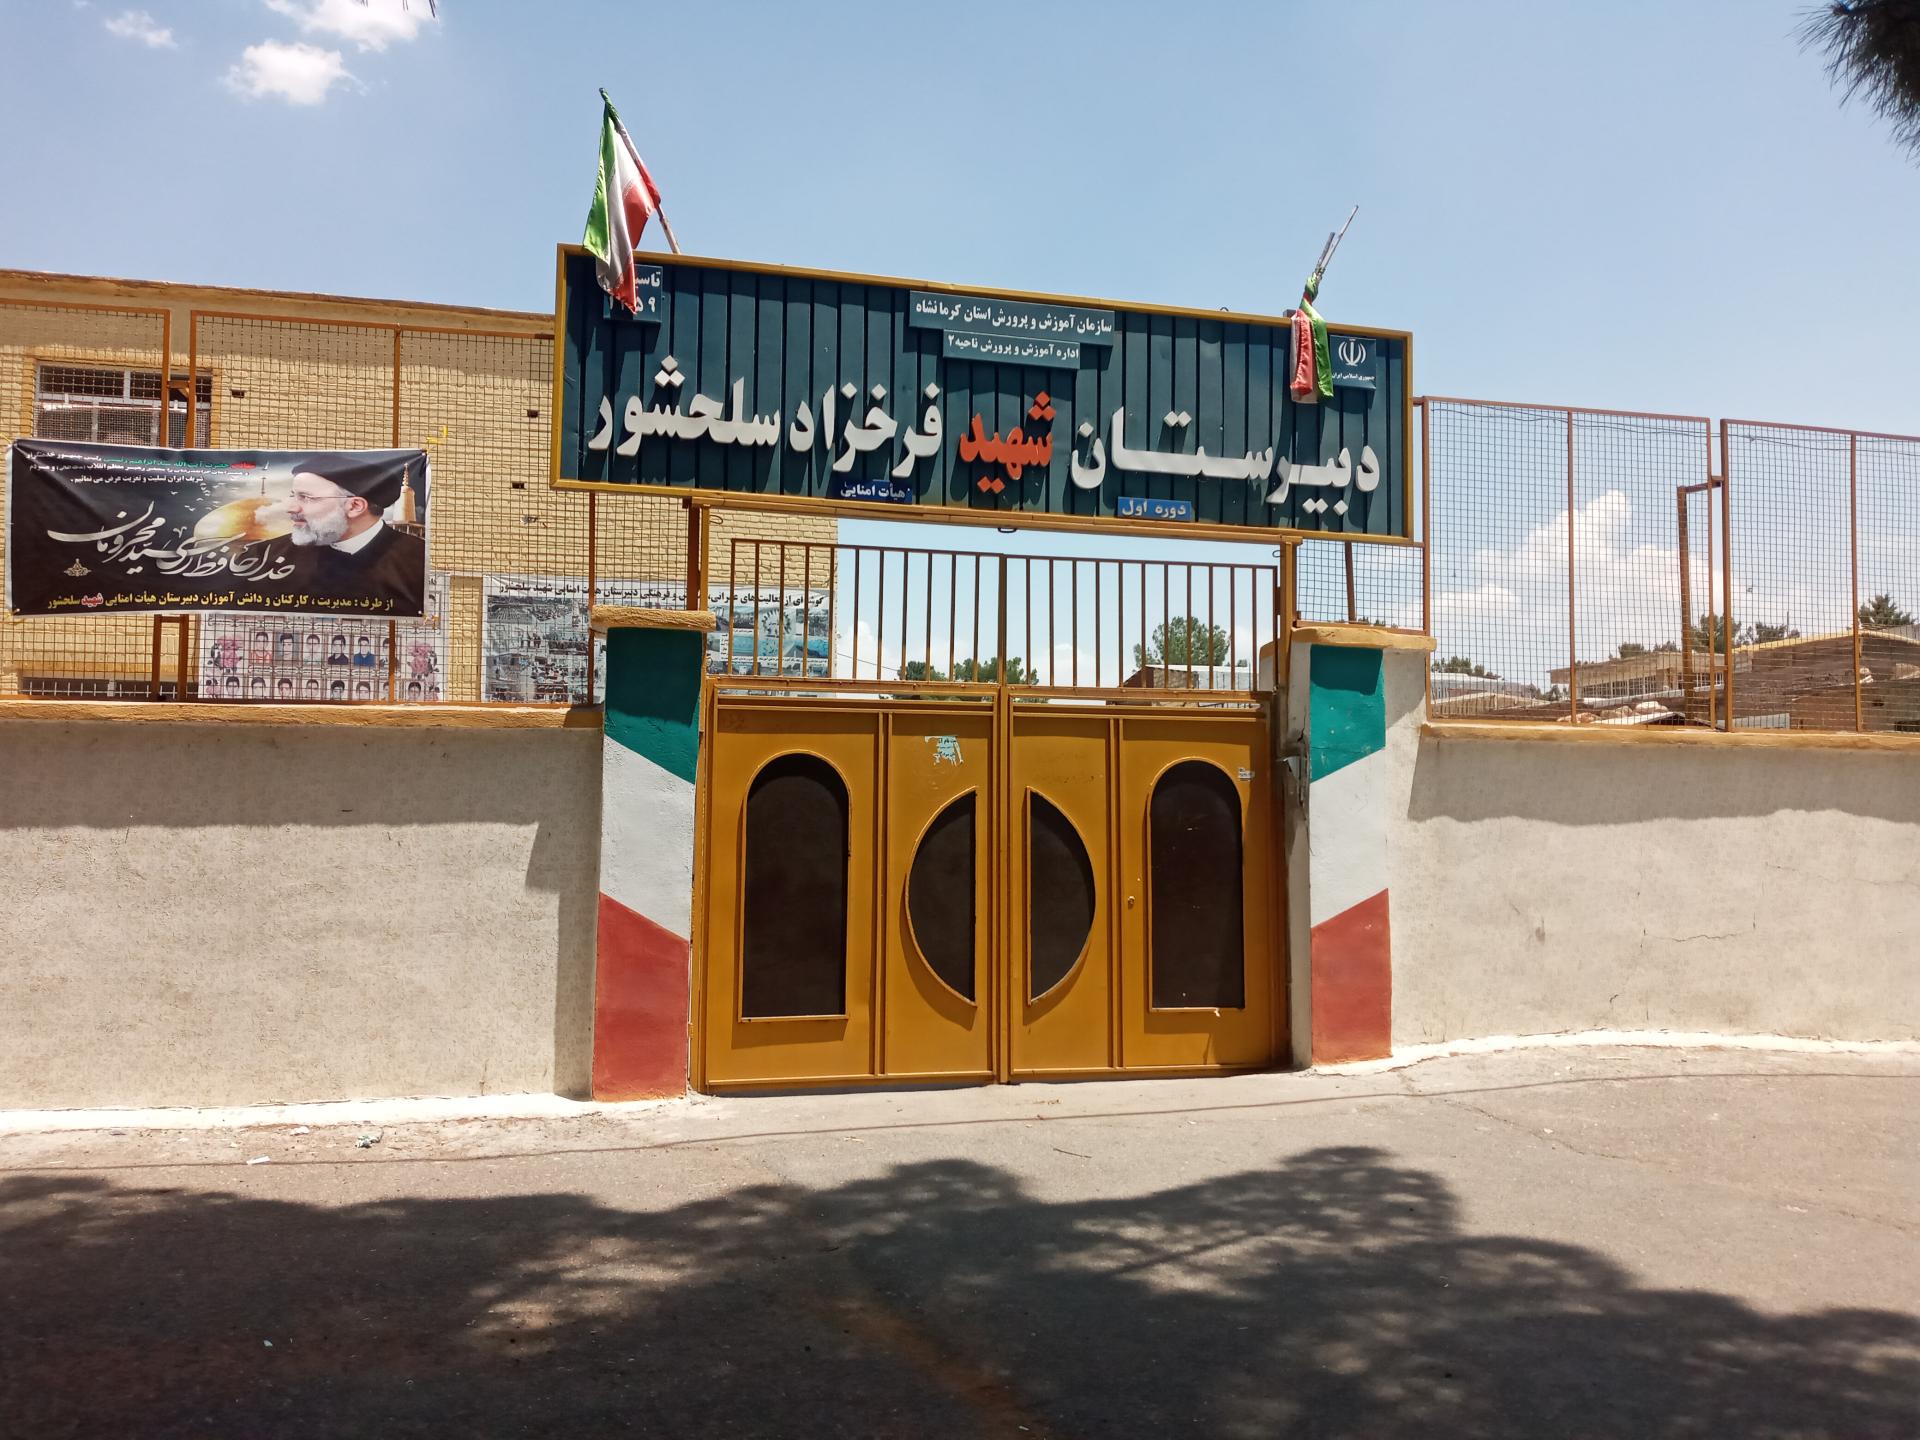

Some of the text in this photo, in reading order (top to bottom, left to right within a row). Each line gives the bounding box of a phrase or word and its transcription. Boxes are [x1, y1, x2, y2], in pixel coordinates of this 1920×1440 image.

[916, 299, 1112, 336] سازمان آموزش و پرورش استان کرمانشاه
[980, 339, 1012, 356] پرورش
[1013, 345, 1020, 356] و
[1021, 343, 1055, 358] آموزش
[1056, 347, 1079, 361] اداره
[1342, 373, 1358, 381] اسلامی
[588, 355, 1380, 515] دبیرستان شهید فرخزاد سلحشور
[93, 476, 104, 484] می
[104, 475, 122, 484] عرض
[122, 474, 142, 484] تعزیت
[148, 474, 167, 482] تسلیت
[167, 475, 185, 484] ایران
[185, 475, 204, 484] شریف
[840, 482, 876, 498] امنایی
[1121, 499, 1187, 519] دوره اول
[499, 581, 532, 593] سلحشور
[533, 583, 553, 594] شهید
[603, 586, 638, 599] دبیرستان
[47, 594, 80, 609] سلحشور
[81, 592, 104, 608] شهید
[105, 592, 133, 607] امنایی
[134, 590, 157, 605] هیأت
[158, 591, 198, 605] دبیرستان
[201, 591, 235, 605] آموزان
[237, 592, 262, 606] دانش
[264, 597, 271, 607] و
[272, 594, 309, 607] کارکنان
[317, 596, 352, 609] مدیریت
[360, 597, 382, 611] طرف
[385, 598, 394, 611] از
